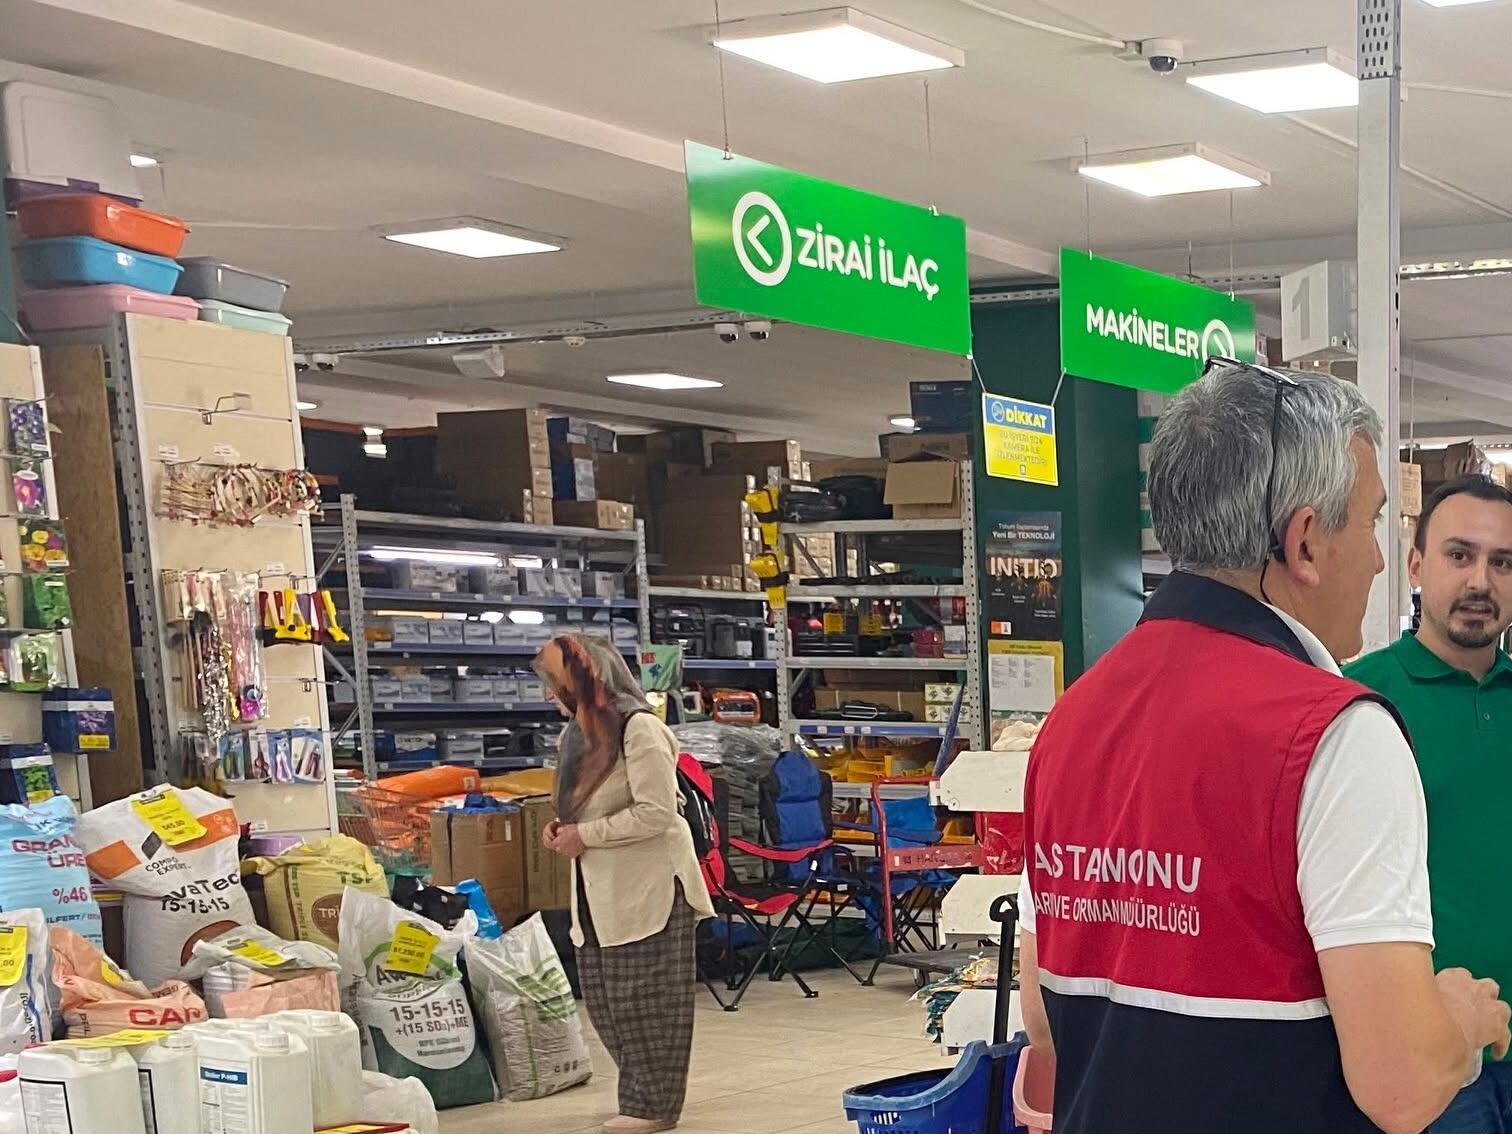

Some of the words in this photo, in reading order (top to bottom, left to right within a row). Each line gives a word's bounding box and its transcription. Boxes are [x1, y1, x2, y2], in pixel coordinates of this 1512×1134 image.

[796, 225, 874, 282] ZİRAİ
[877, 238, 940, 301] İLAÇ
[1086, 302, 1199, 360] MAKİNELER
[1005, 405, 1048, 428] DİKKAT
[990, 556, 1058, 579] INITIO
[52, 886, 89, 905] %46
[389, 998, 466, 1022] 15-15-15
